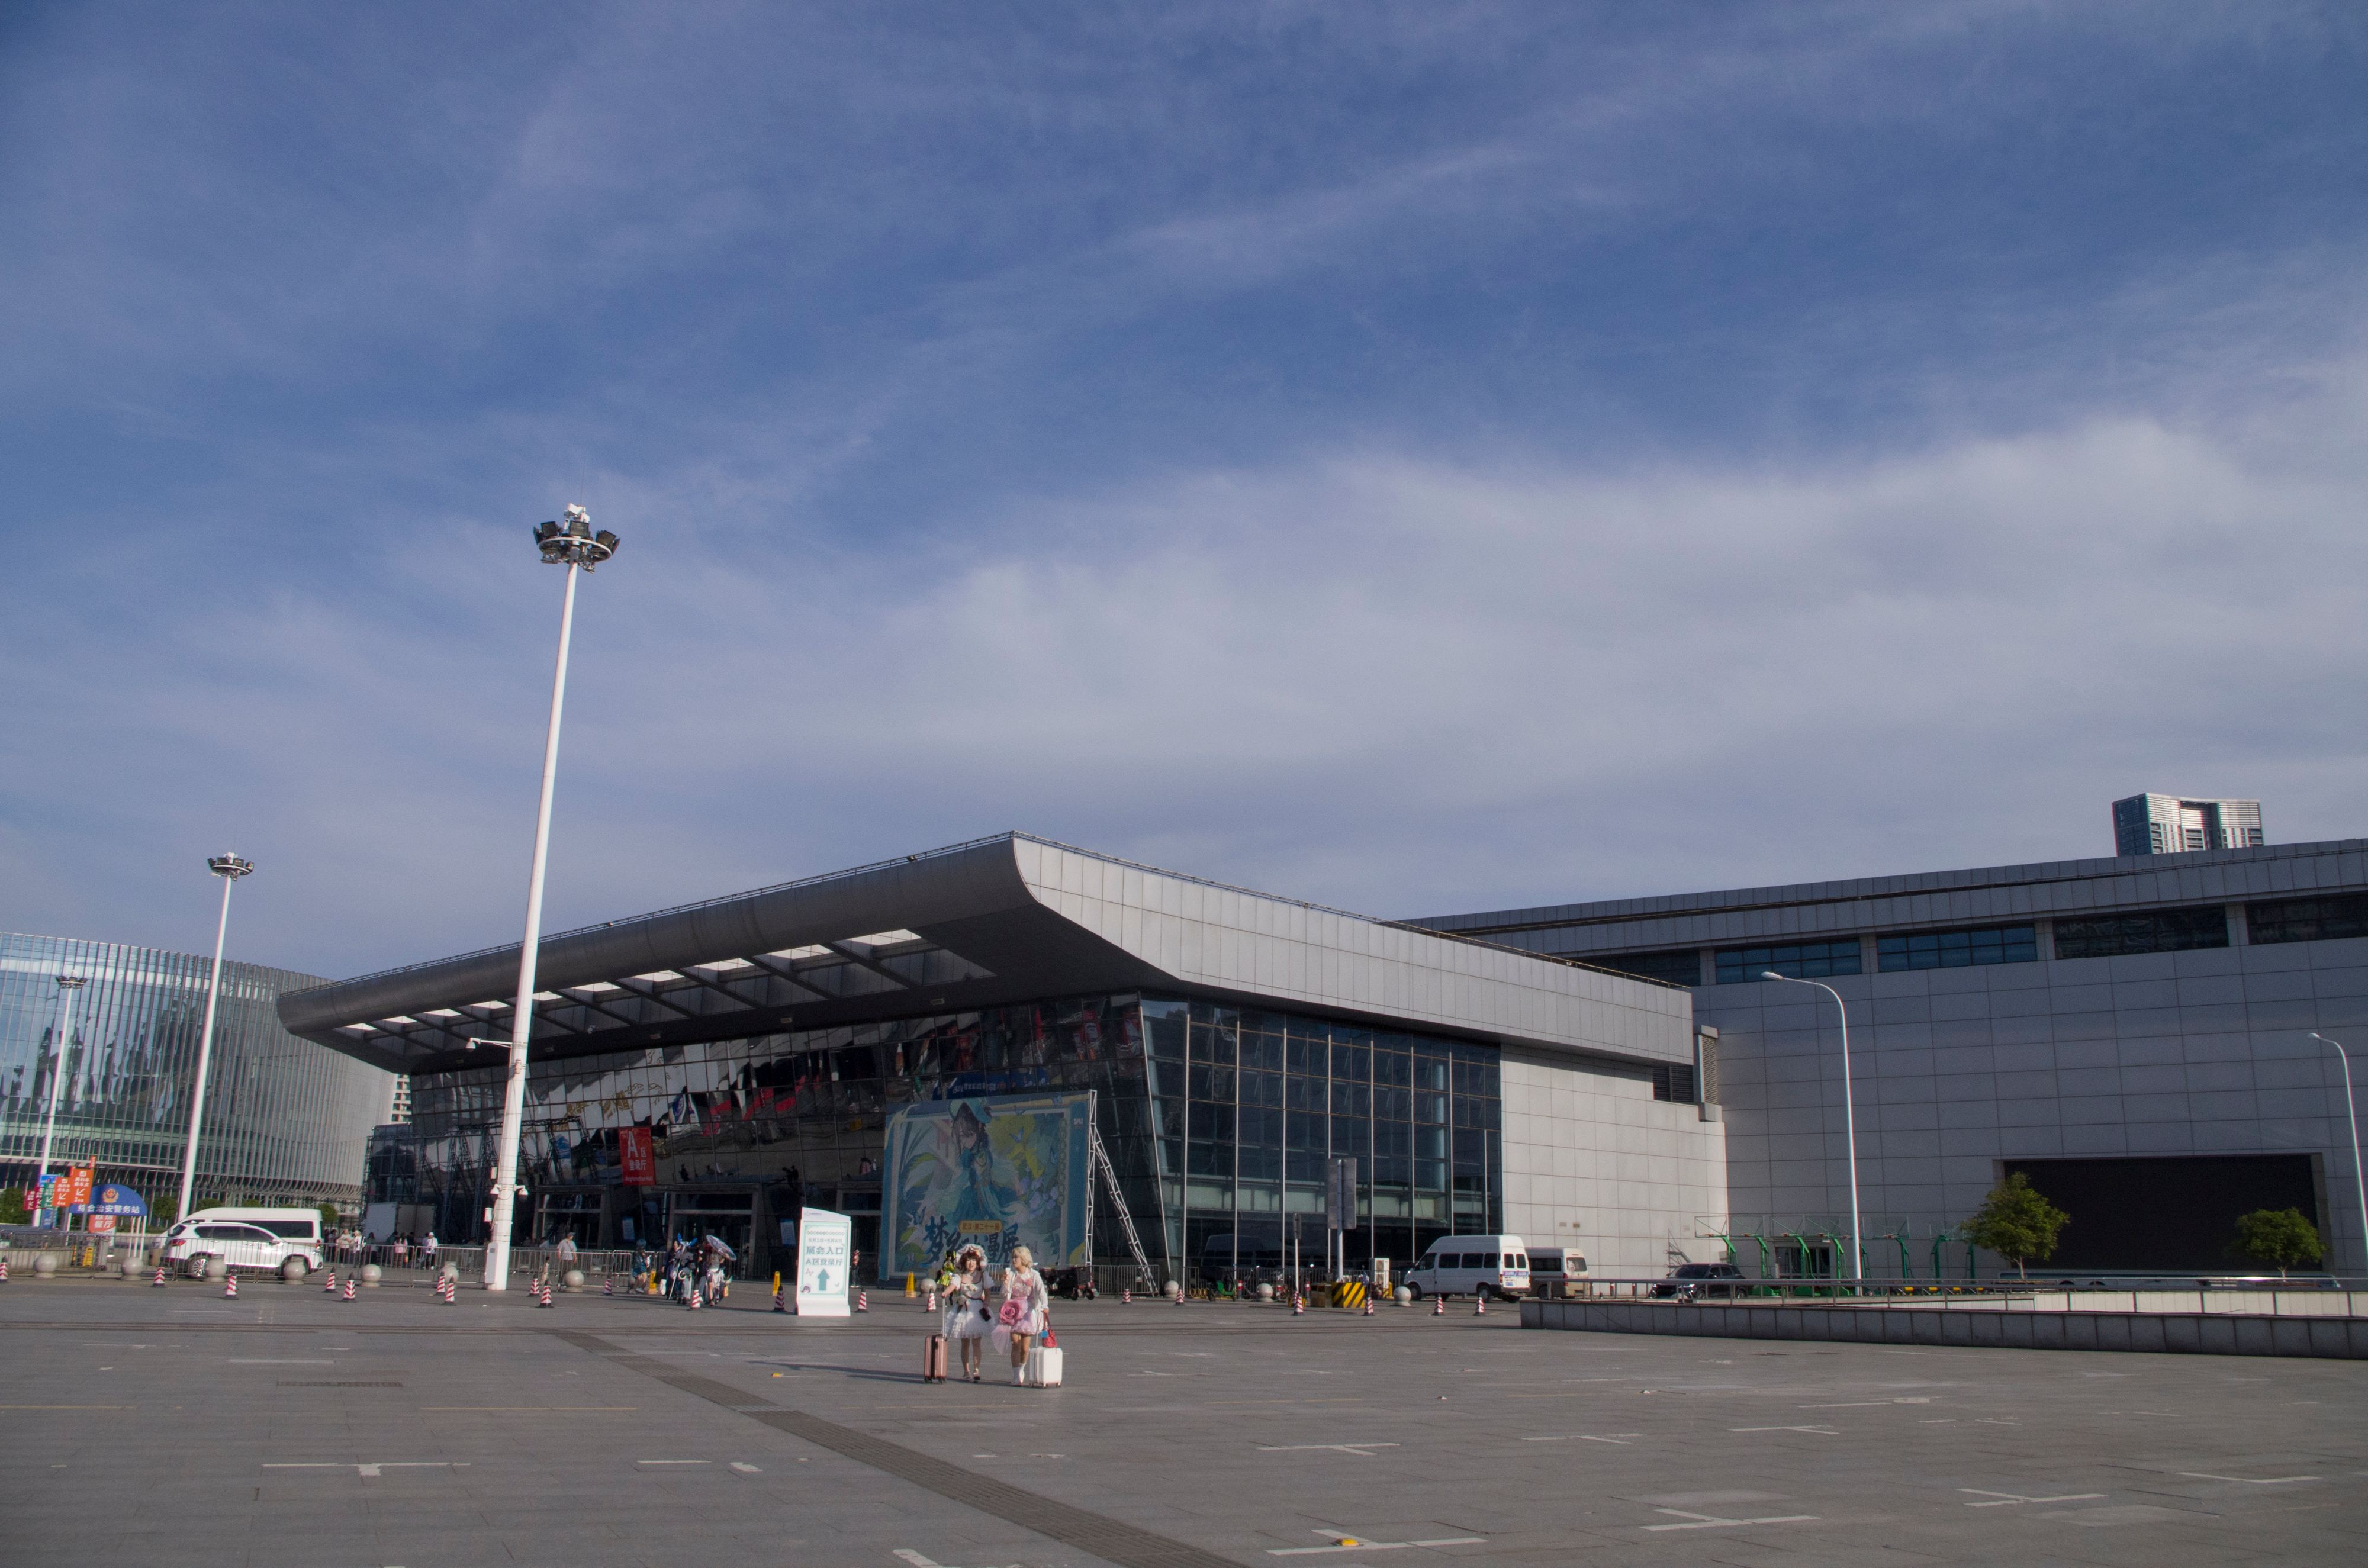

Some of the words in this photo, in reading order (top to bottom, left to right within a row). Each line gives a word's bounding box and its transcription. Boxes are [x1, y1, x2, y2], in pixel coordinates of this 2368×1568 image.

[629, 1160, 646, 1171] 登录厅
[78, 1204, 140, 1213] 综合治安警务站
[807, 1246, 844, 1254] 展会入口
